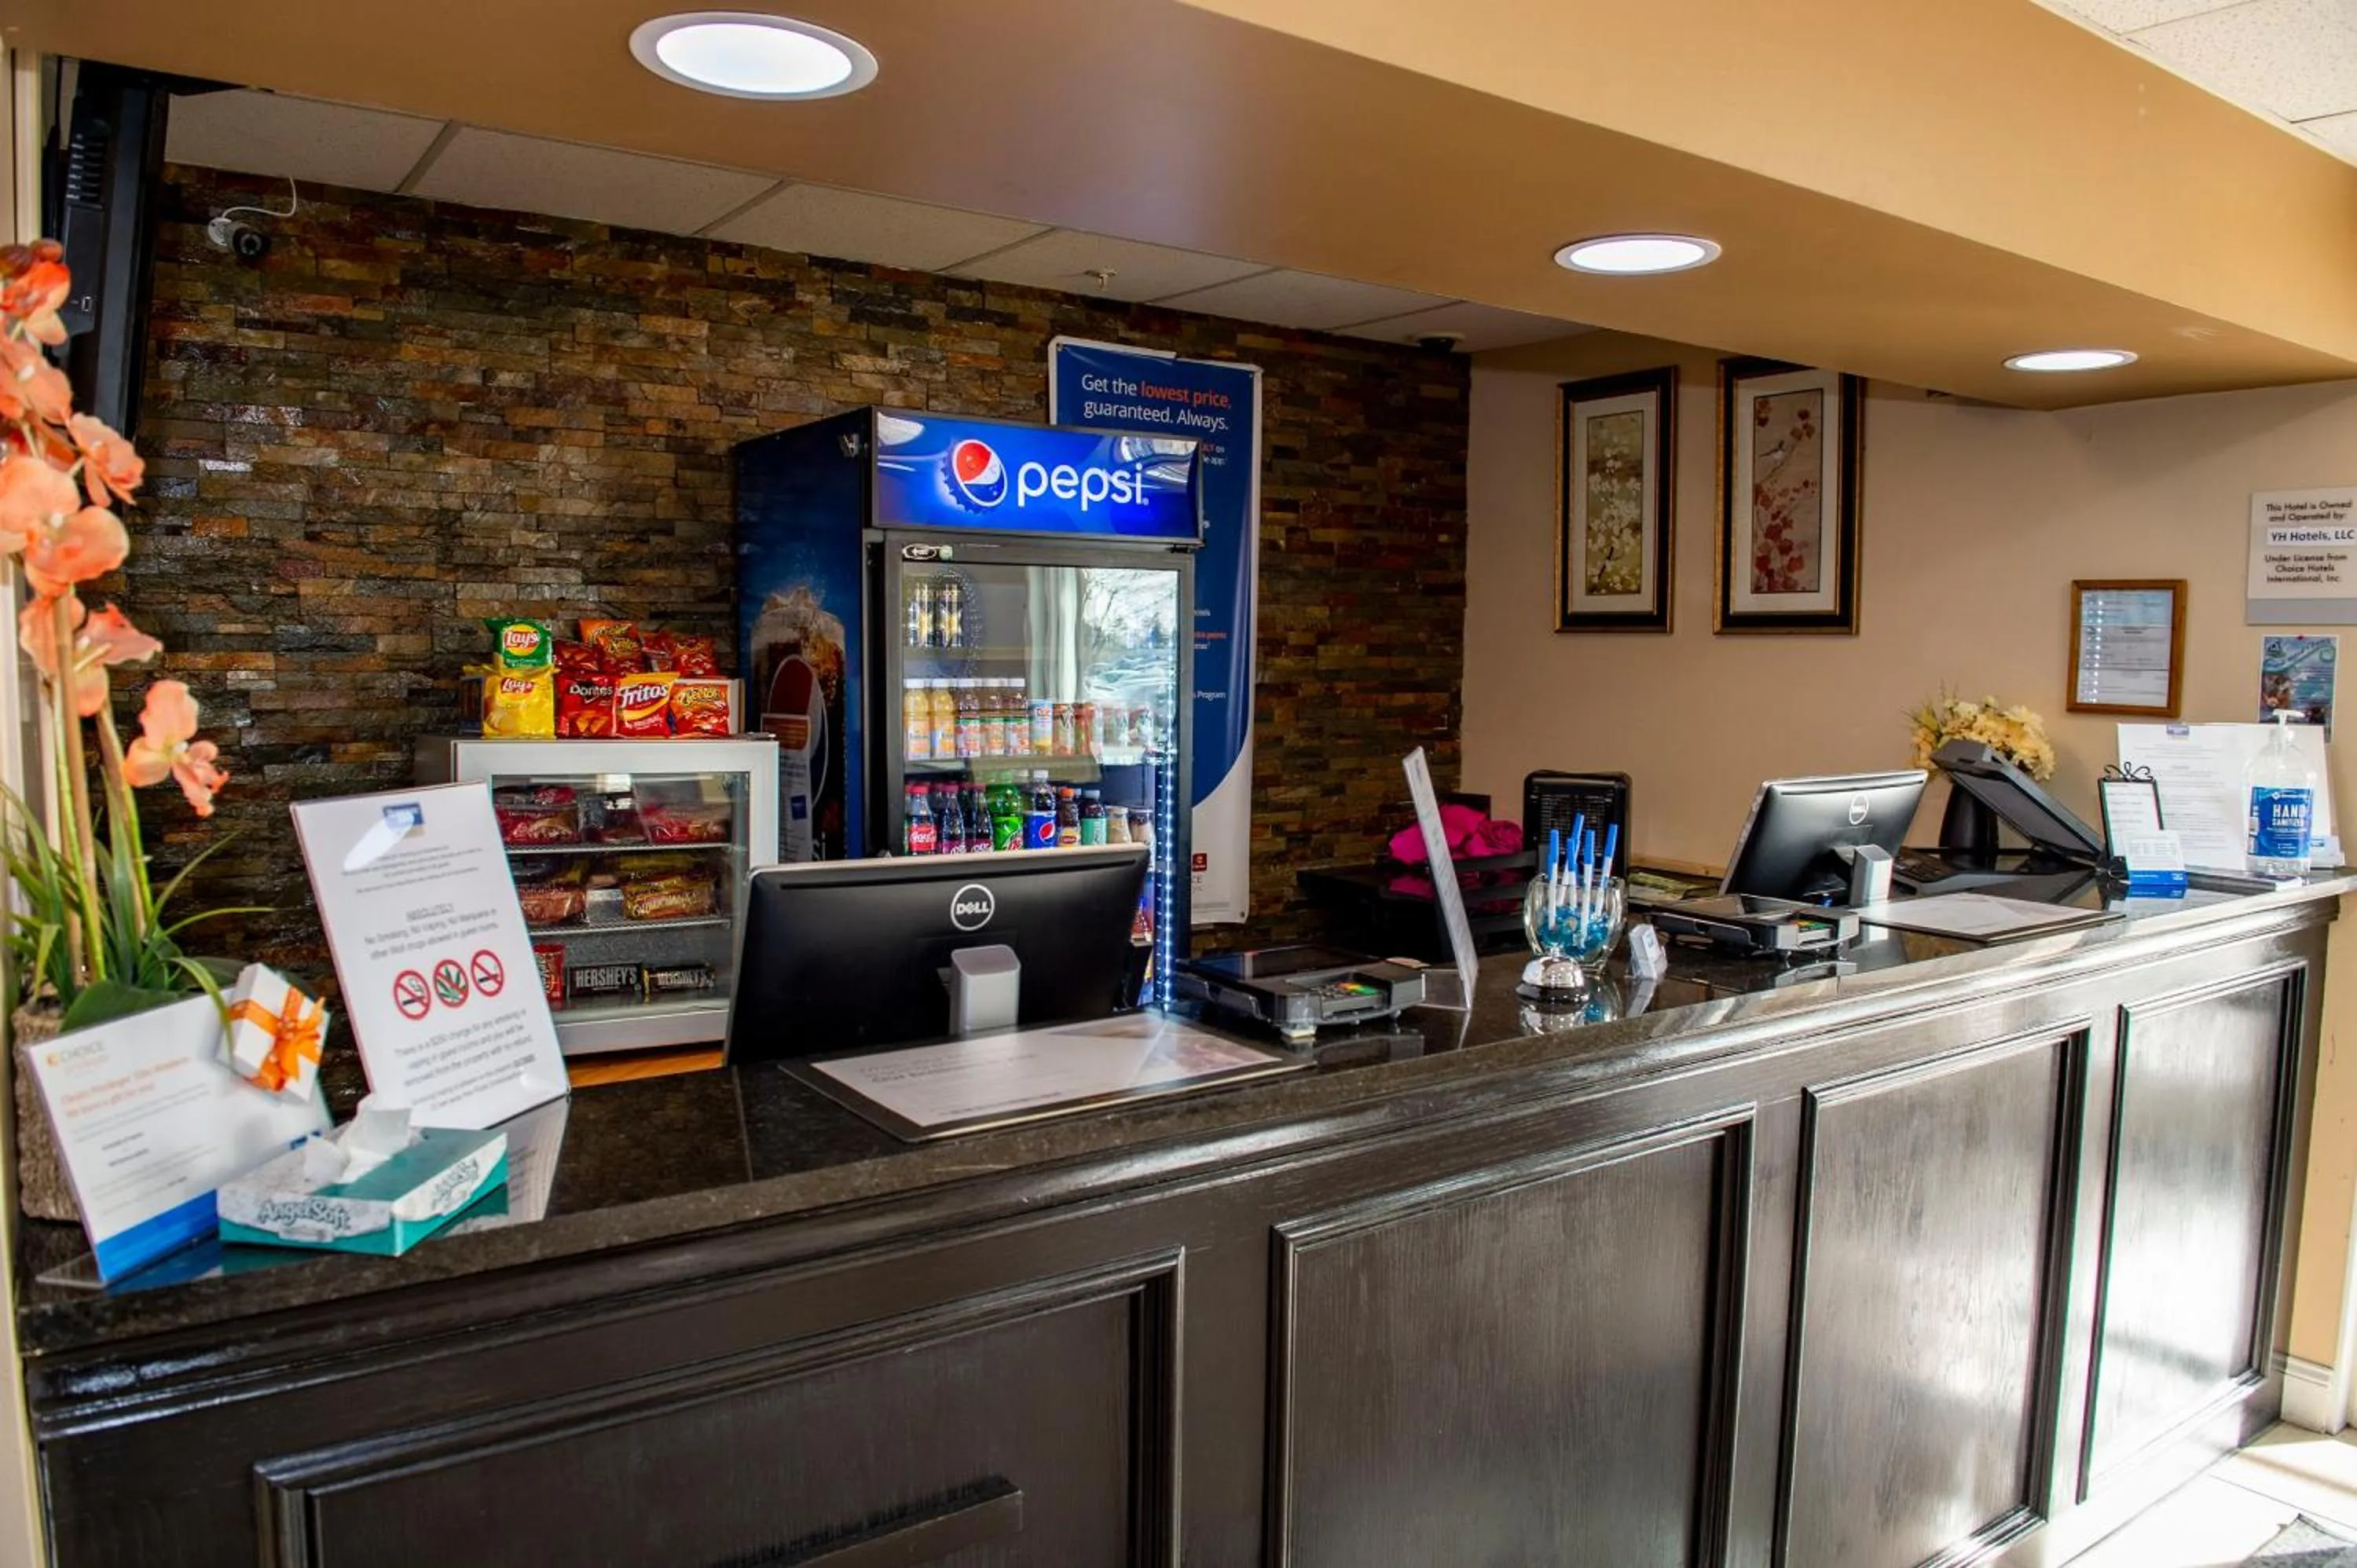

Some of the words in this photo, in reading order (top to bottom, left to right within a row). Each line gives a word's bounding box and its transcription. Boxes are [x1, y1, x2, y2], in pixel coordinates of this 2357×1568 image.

[1081, 374, 1109, 392] Get
[1113, 379, 1137, 396] the
[1141, 380, 1189, 403] lowest
[1083, 401, 1173, 424] guaranteed.
[1177, 409, 1230, 433] Always.
[1017, 462, 1142, 511] pepsi
[2266, 503, 2282, 511] This
[2284, 502, 2308, 511] Hotel
[2319, 500, 2352, 510] Owned
[2288, 511, 2331, 522] Operated
[2271, 532, 2287, 541] YH
[2334, 529, 2355, 540] LLC
[2265, 554, 2290, 562] Under
[2326, 552, 2348, 562] from
[2308, 563, 2335, 572] Hotels
[2273, 804, 2306, 818] HAND
[955, 901, 989, 915] DELL
[576, 967, 637, 987] HERSHEY'S
